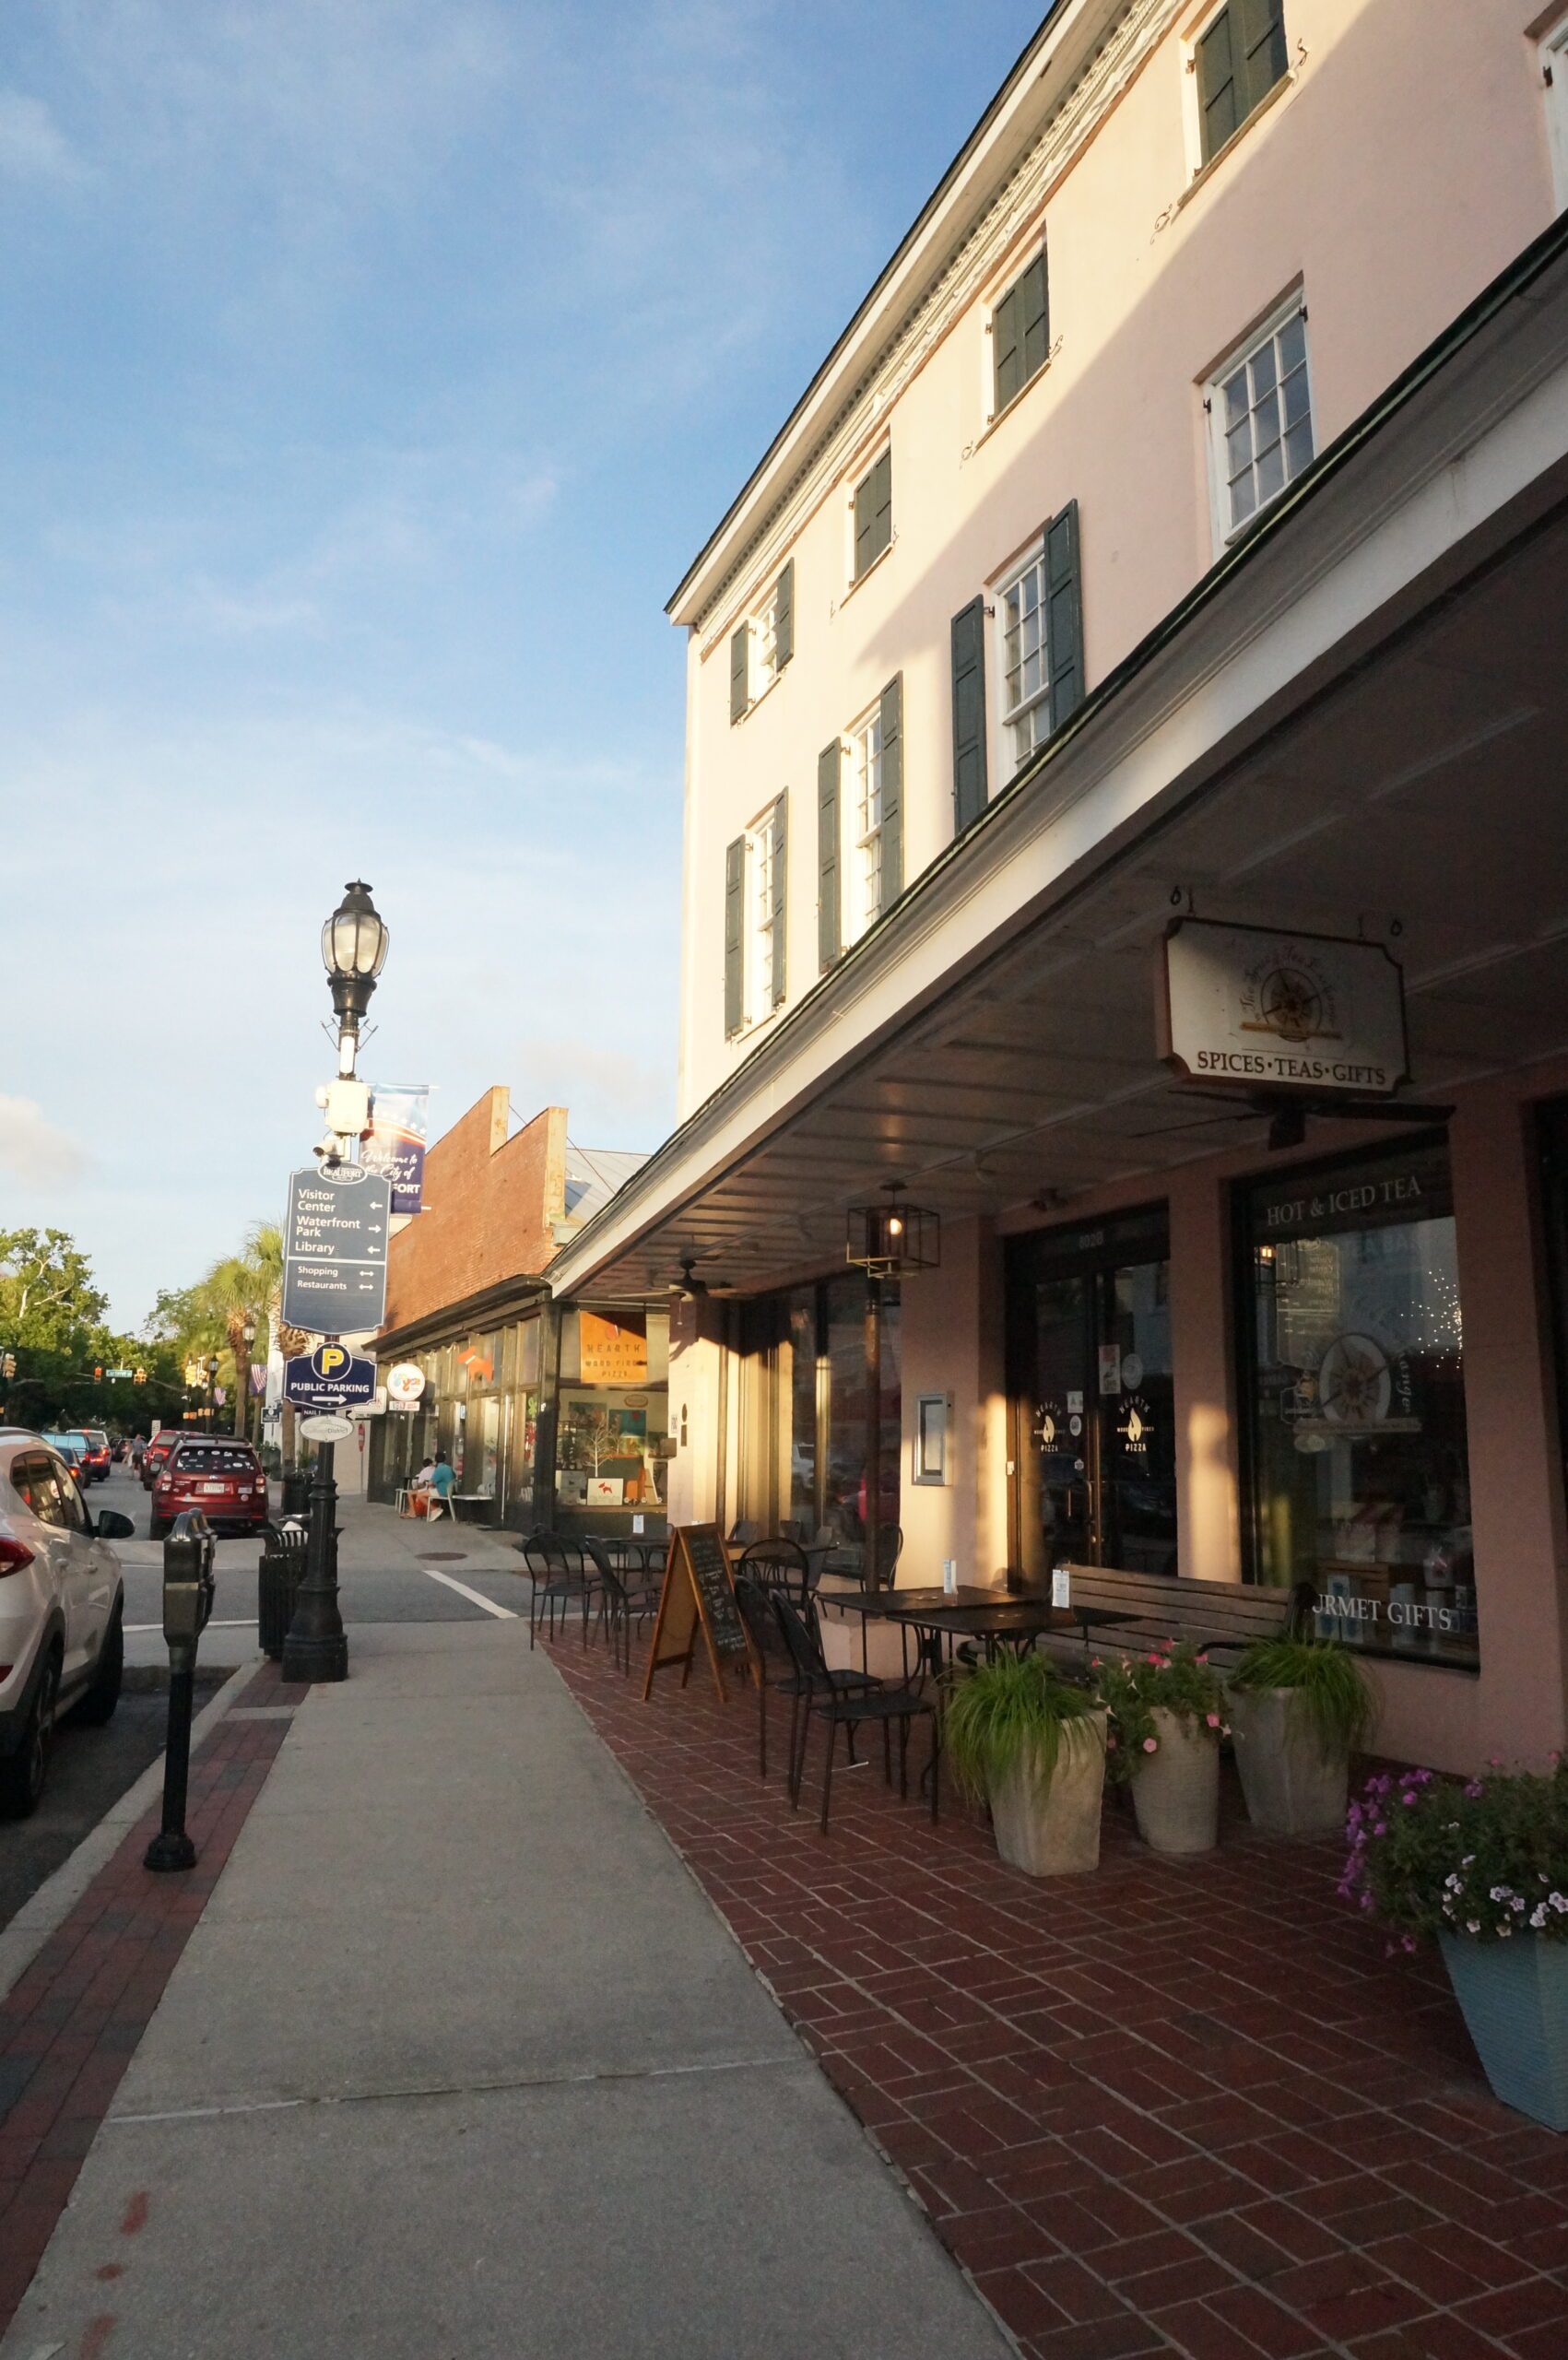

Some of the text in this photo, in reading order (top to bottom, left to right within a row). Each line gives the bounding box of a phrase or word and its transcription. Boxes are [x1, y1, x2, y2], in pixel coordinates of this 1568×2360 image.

[1197, 1050, 1386, 1085] SPICES TEAS GIFTS
[361, 1150, 418, 1165] Welcome to
[380, 1163, 402, 1182] City
[403, 1166, 416, 1180] of
[298, 1188, 336, 1200] Visitor
[298, 1200, 336, 1212] Center
[1267, 1175, 1422, 1227] HOT & ICED TEA
[296, 1215, 360, 1230] Waterfront
[296, 1226, 321, 1237] Park
[295, 1241, 335, 1256] Library
[298, 1266, 338, 1278] Shopping
[297, 1280, 348, 1290] Restaurants
[587, 1343, 641, 1353] HEARTH
[321, 1348, 345, 1375] P
[290, 1382, 370, 1393] PUBLIC PARKING
[1041, 1445, 1058, 1453] PIZZA
[1125, 1443, 1147, 1452] PIZZA
[1387, 1602, 1452, 1631] GIFTS
